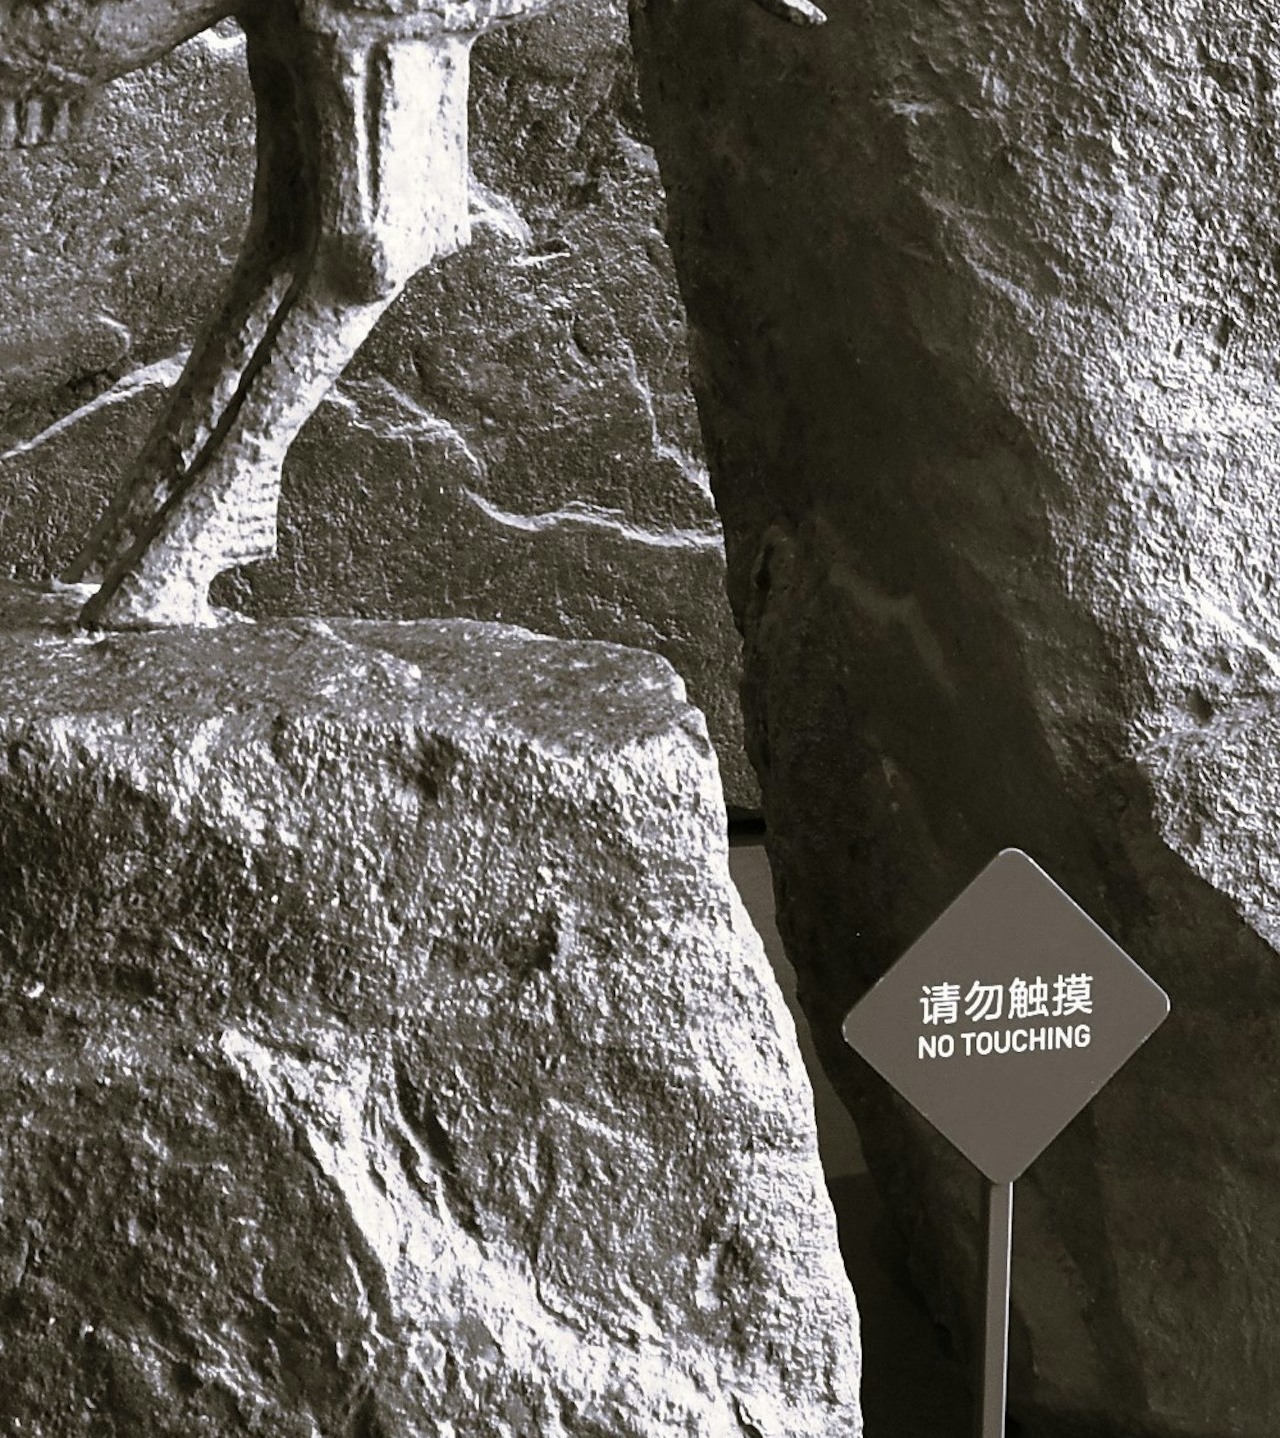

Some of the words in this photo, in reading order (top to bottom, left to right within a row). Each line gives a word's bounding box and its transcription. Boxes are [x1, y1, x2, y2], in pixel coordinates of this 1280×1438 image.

[919, 972, 1094, 1026] 请勿触摸
[918, 1034, 955, 1059] NO
[960, 1024, 1092, 1056] TOUCHING
